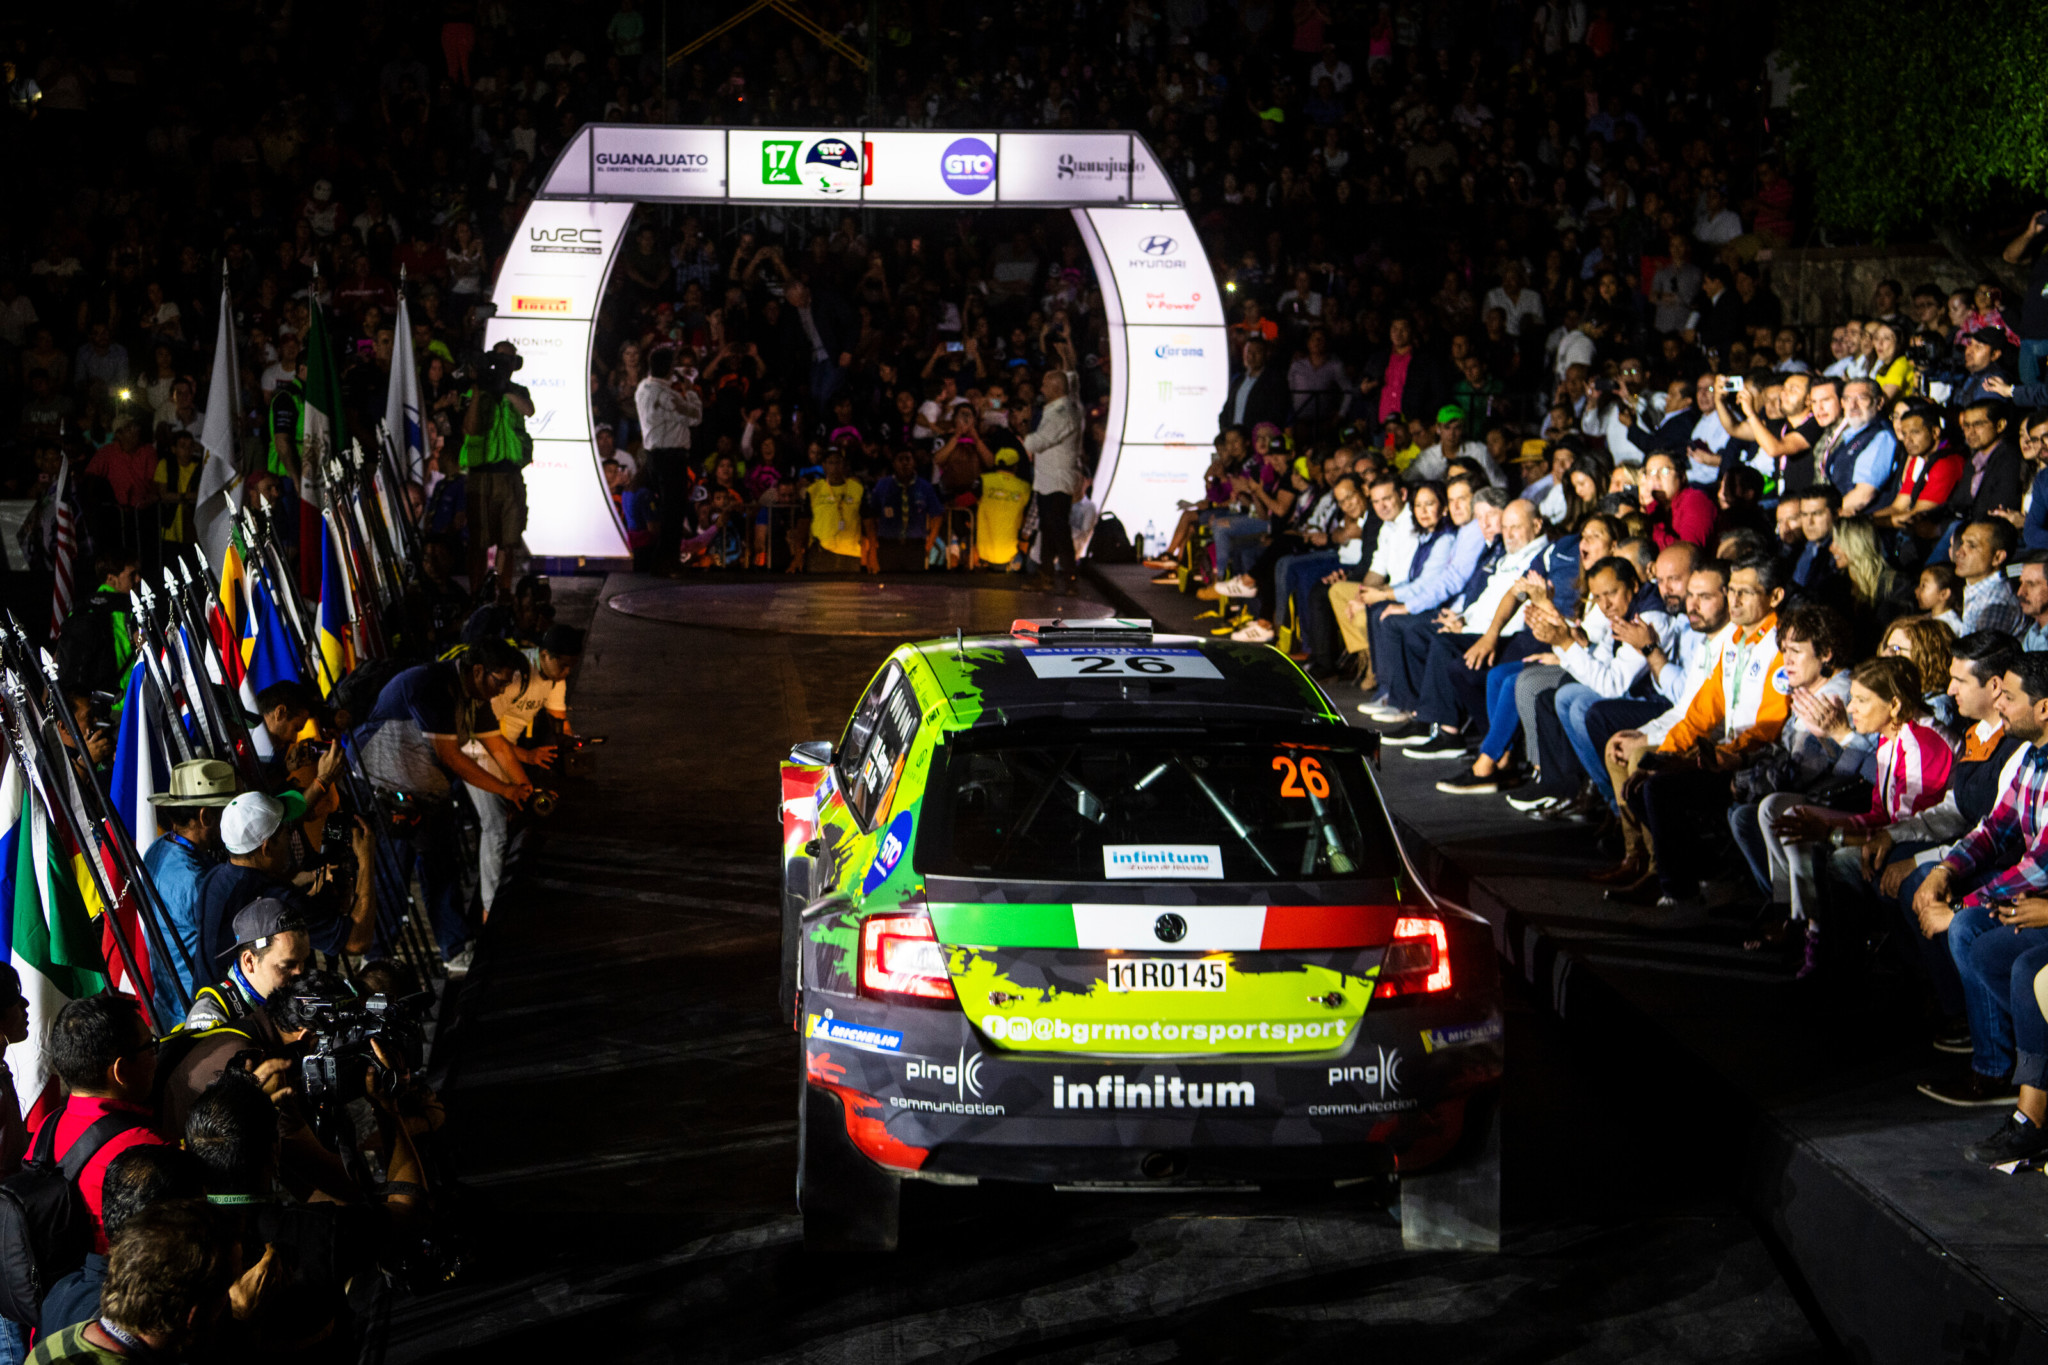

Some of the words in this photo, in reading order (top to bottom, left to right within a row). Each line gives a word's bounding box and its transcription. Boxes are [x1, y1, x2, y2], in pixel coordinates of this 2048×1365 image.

[596, 153, 708, 167] GUANAJUATO
[764, 145, 794, 169] 17
[944, 154, 993, 174] GTO
[530, 227, 602, 244] WRC
[1129, 259, 1186, 269] HYUNDAI
[517, 298, 567, 311] PIRELLI
[1155, 344, 1204, 358] Corona
[1070, 656, 1175, 674] 26
[1271, 756, 1330, 799] 26
[1112, 851, 1209, 864] infinitum
[1109, 963, 1224, 989] 11R0145
[830, 1026, 899, 1048] MICHELIN
[1032, 1017, 1347, 1045] @bgrmotorsportsport
[1448, 1025, 1500, 1042] MICHELIN
[1328, 1064, 1378, 1086] ping
[1052, 1075, 1256, 1109] infinitum
[890, 1096, 1005, 1116] communication
[1308, 1098, 1418, 1116] communication
